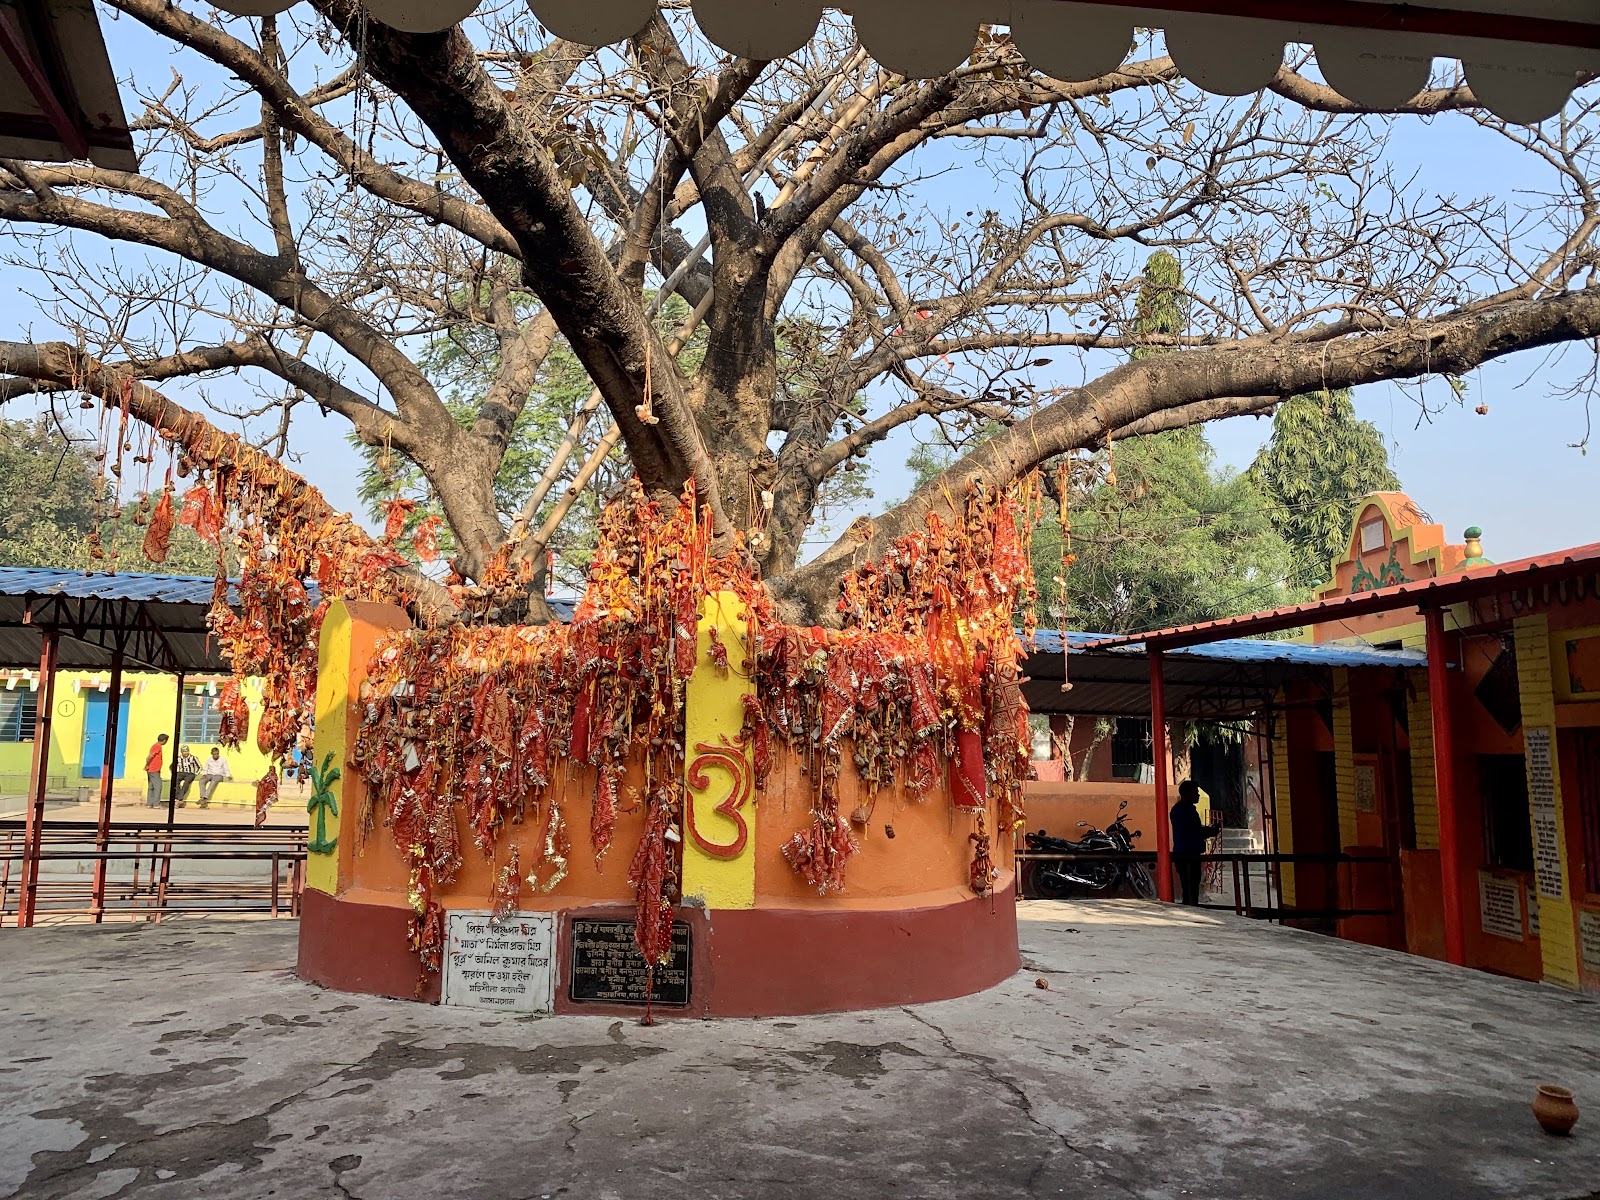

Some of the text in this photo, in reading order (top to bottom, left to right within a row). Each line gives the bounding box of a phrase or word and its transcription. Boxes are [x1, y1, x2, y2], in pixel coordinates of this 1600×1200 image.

[466, 921, 485, 934] পিতা
[460, 939, 478, 949] মাতা
[527, 938, 542, 952] মিত্র
[475, 952, 500, 965] অনিল
[502, 956, 526, 969] কুমার
[479, 996, 516, 1006] আসানসোল
